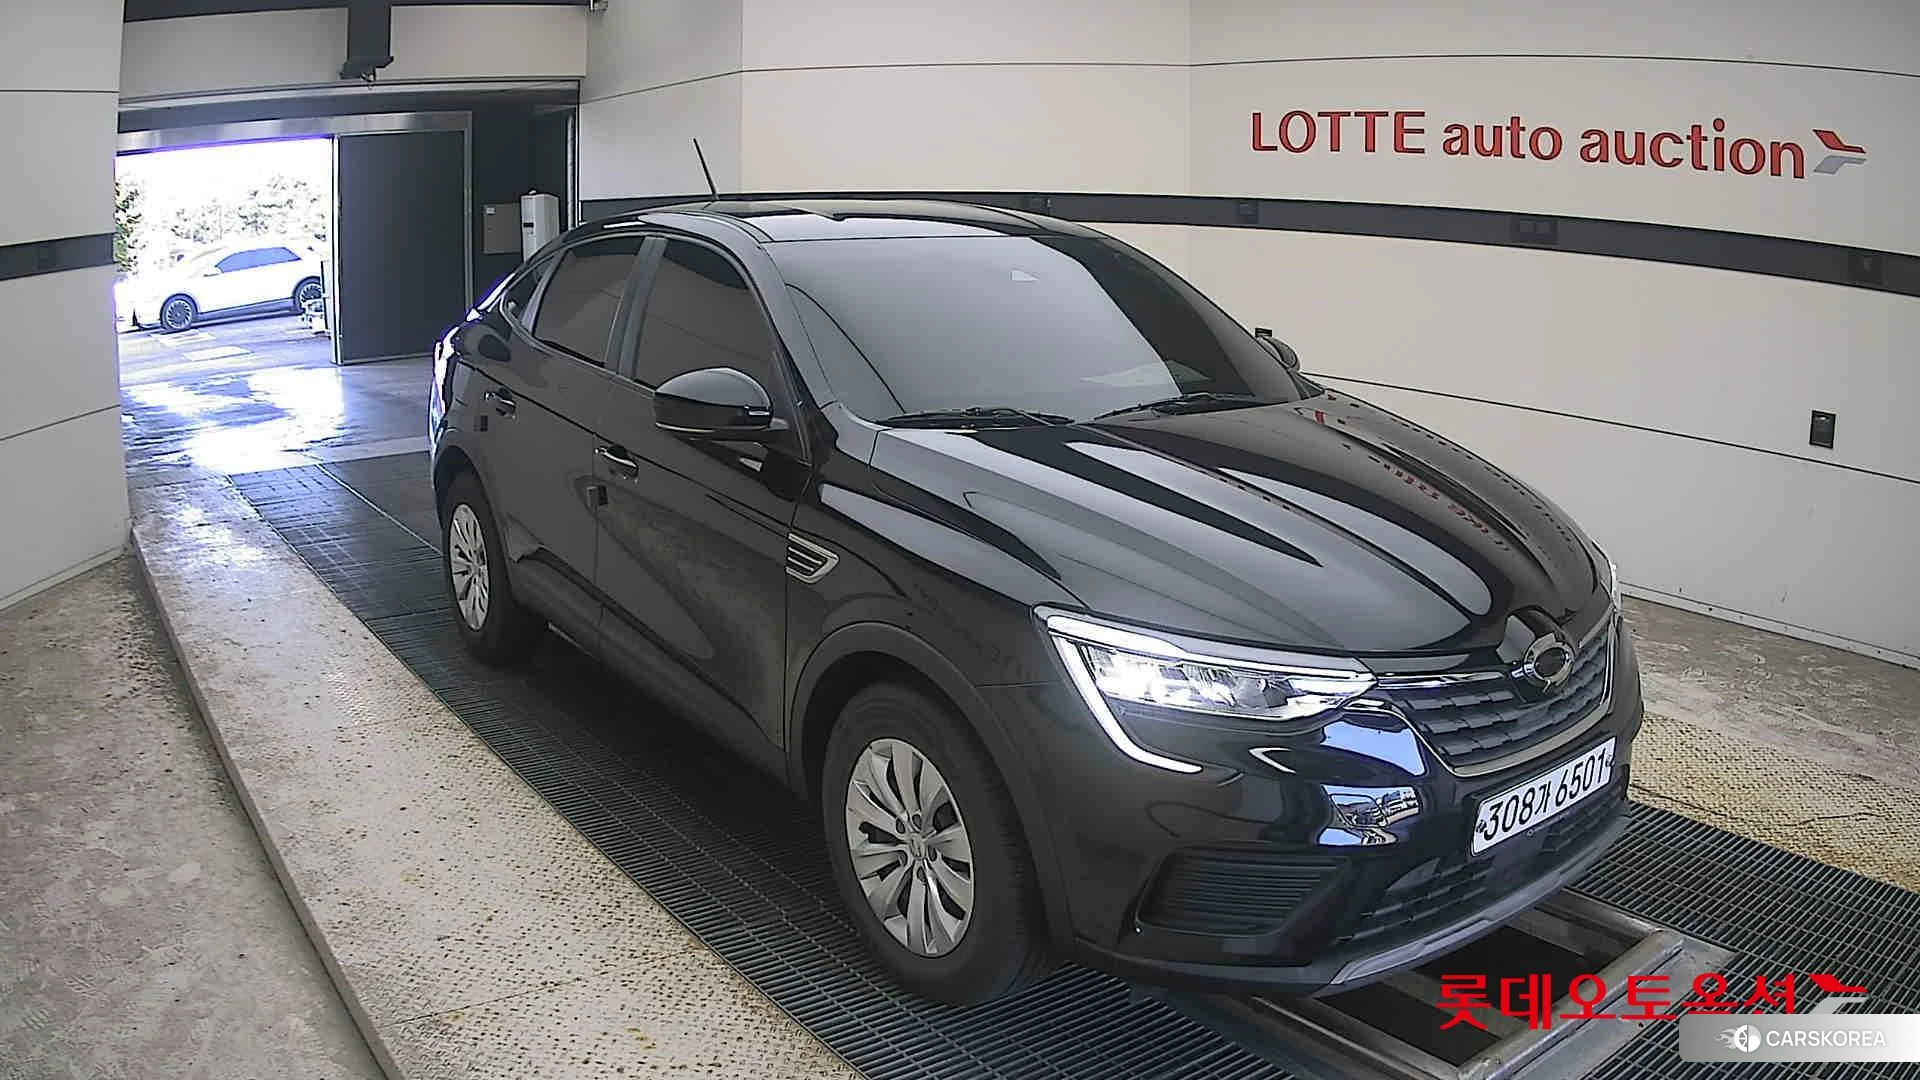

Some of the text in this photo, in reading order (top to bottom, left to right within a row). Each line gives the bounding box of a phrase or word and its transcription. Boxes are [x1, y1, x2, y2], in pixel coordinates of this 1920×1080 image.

[1252, 110, 1806, 179] LOTTE auto auction
[1555, 748, 1606, 808] 6501
